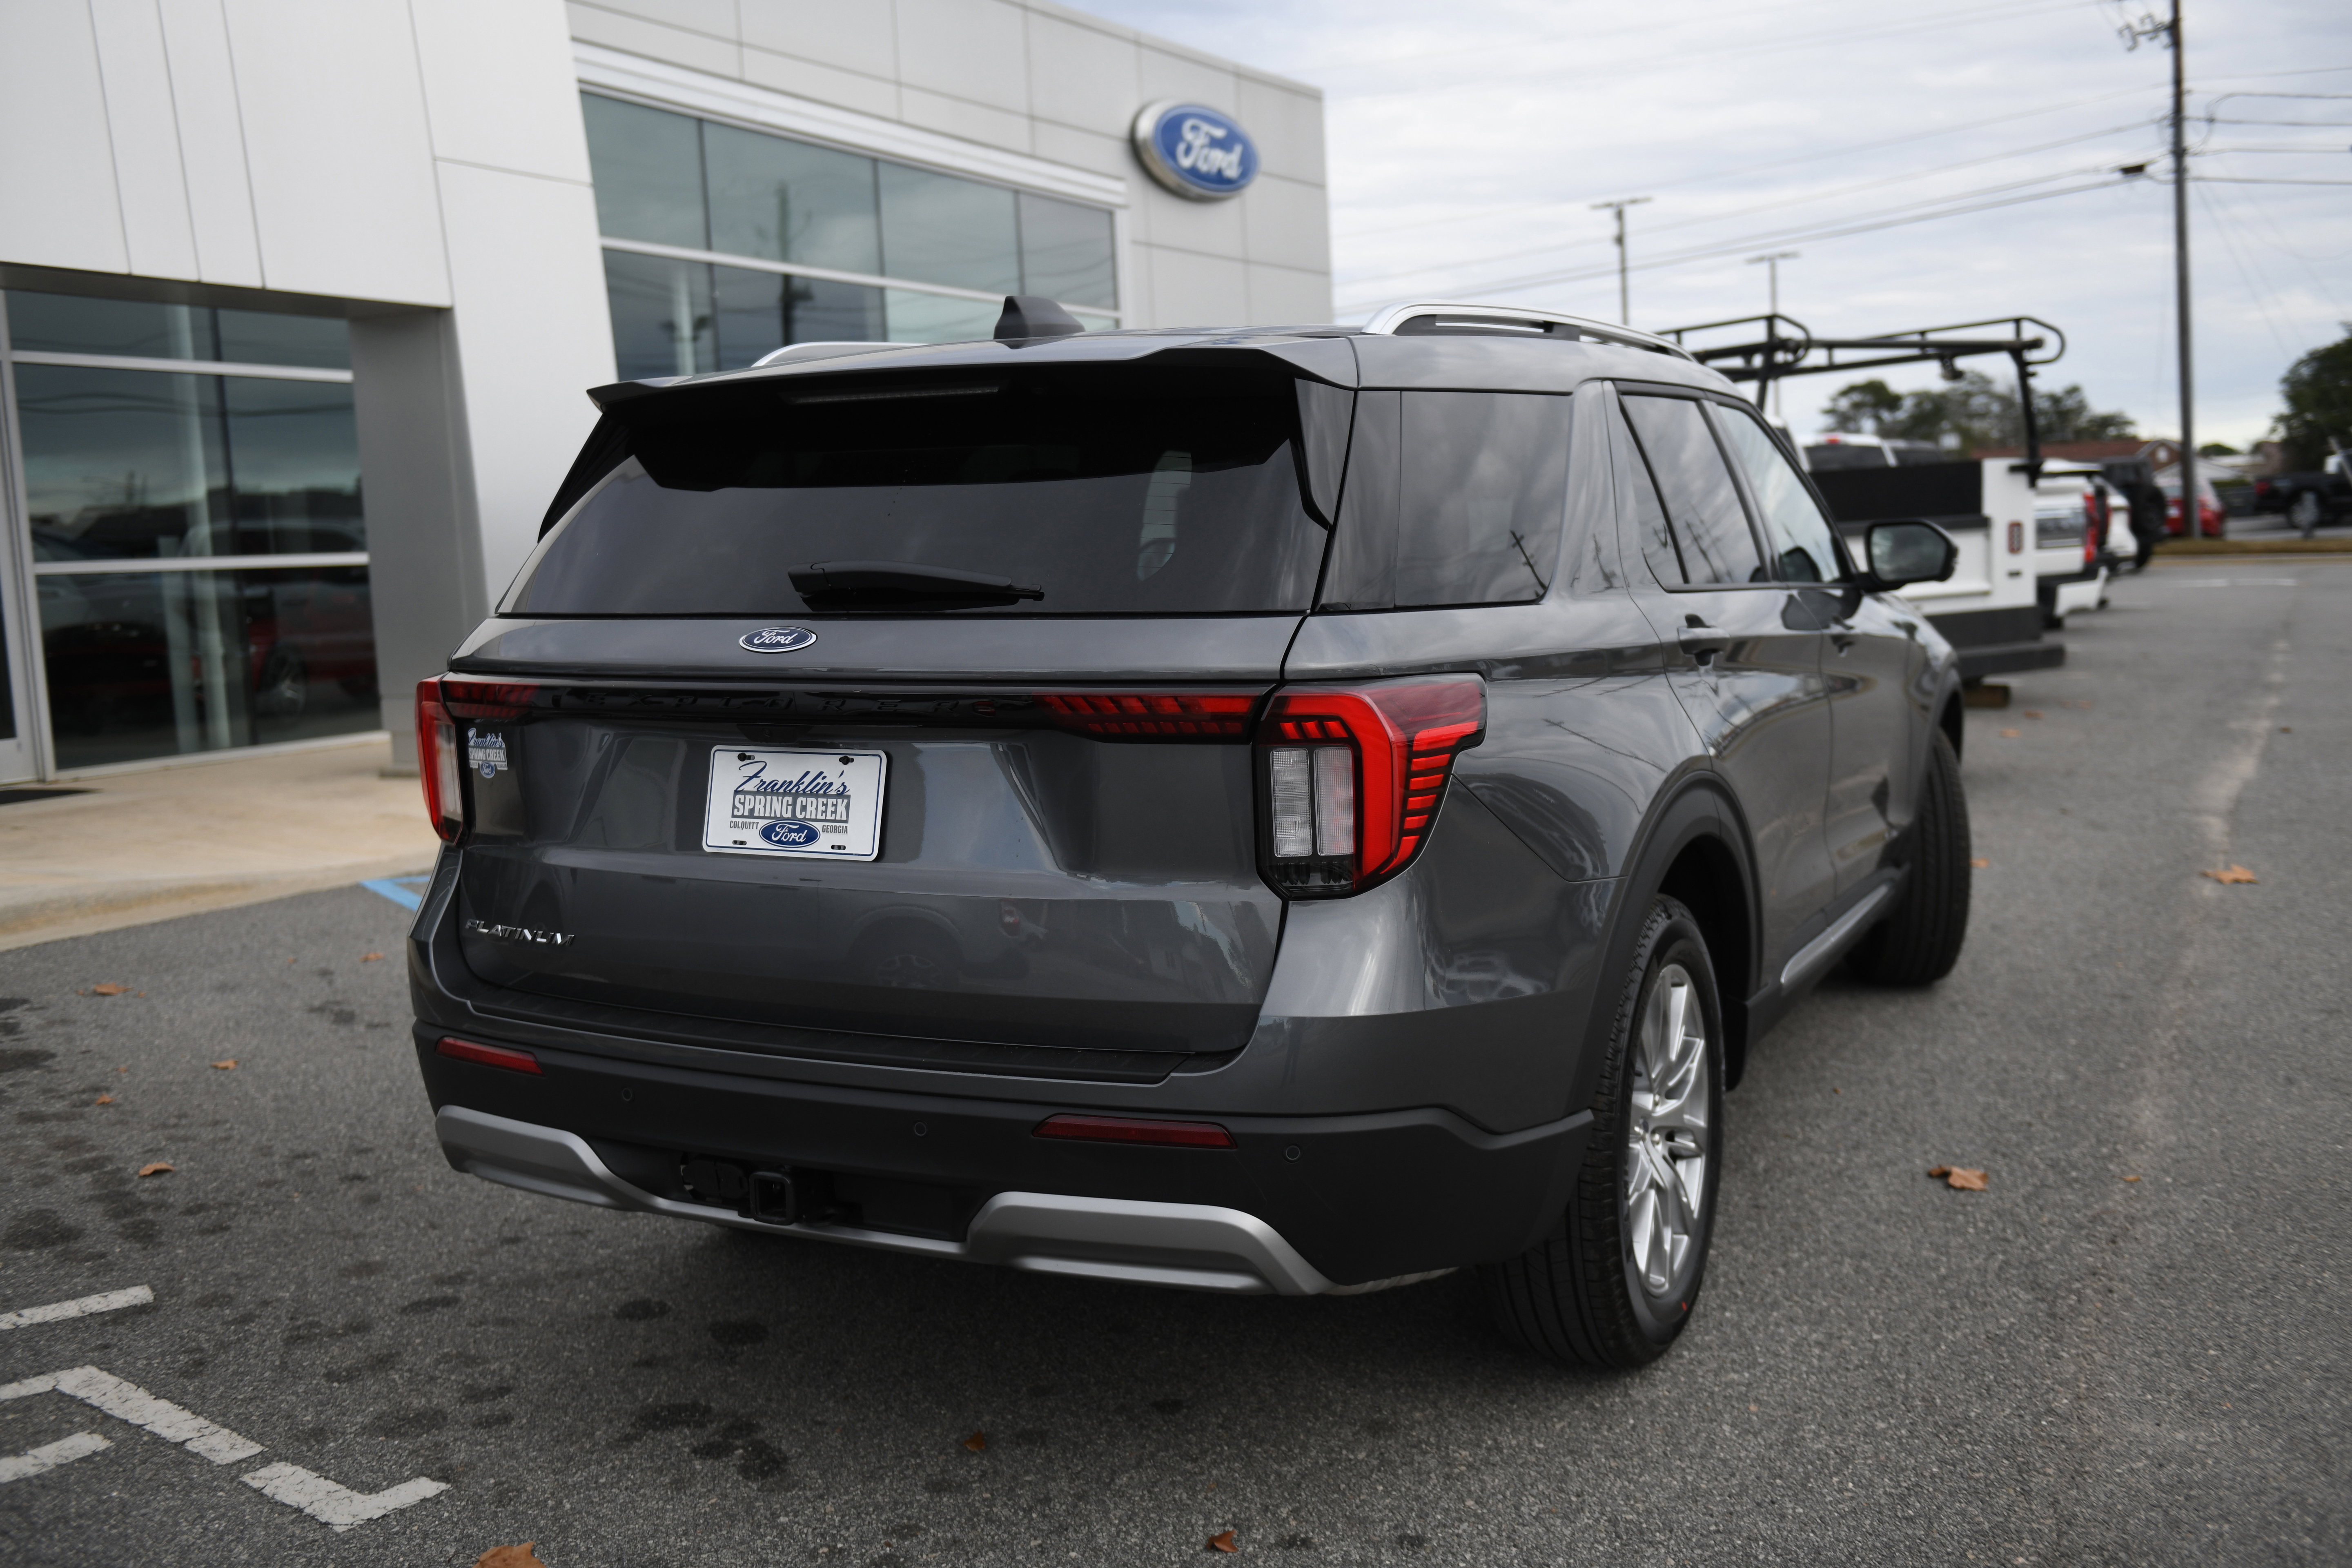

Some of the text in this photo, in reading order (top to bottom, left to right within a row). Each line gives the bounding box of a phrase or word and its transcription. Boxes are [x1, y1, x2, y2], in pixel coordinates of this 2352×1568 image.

[1176, 118, 1243, 180] Ford
[754, 630, 798, 644] Ford
[583, 692, 959, 713] EXPLORER
[468, 728, 504, 747] Franklin's
[469, 748, 505, 761] SPRING CREEK
[483, 763, 492, 774] Ford
[735, 760, 850, 795] Franklin's
[734, 794, 848, 820] SPRING CREEK
[730, 820, 848, 834] COLQUITT GEORGIA
[771, 823, 808, 842] Ford
[465, 919, 575, 946] PLATINUM
